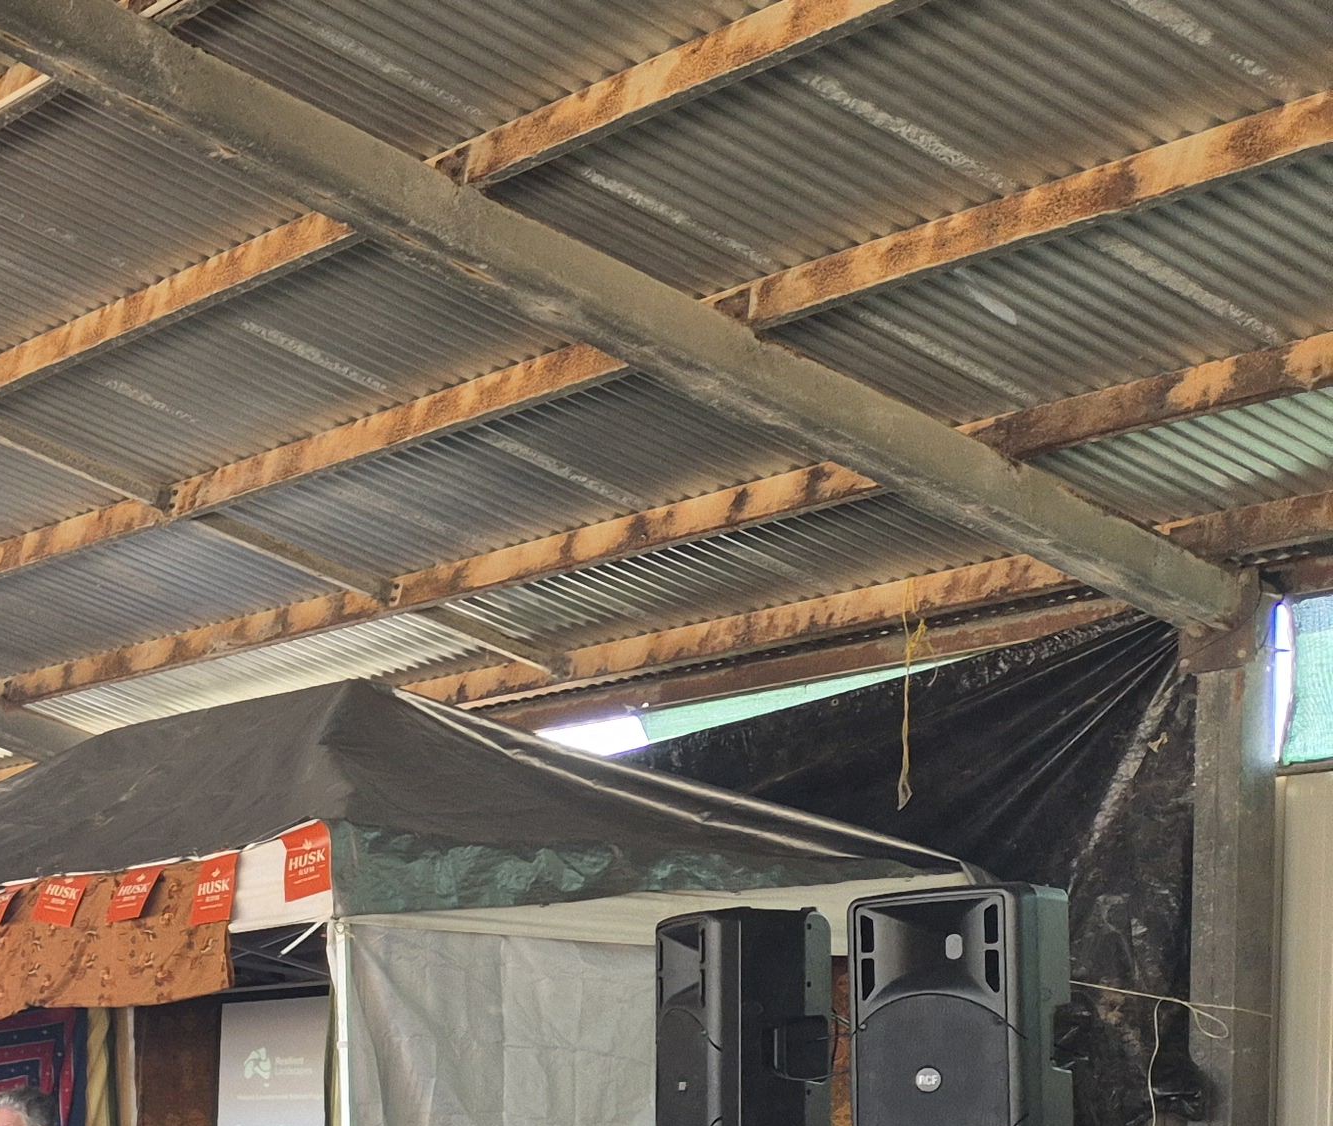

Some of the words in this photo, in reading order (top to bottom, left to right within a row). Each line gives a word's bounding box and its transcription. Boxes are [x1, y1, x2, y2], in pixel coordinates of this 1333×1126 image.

[288, 847, 326, 871] HUSK
[45, 884, 80, 900] HUSK
[117, 882, 151, 896] HUSK
[197, 878, 231, 896] HUSK
